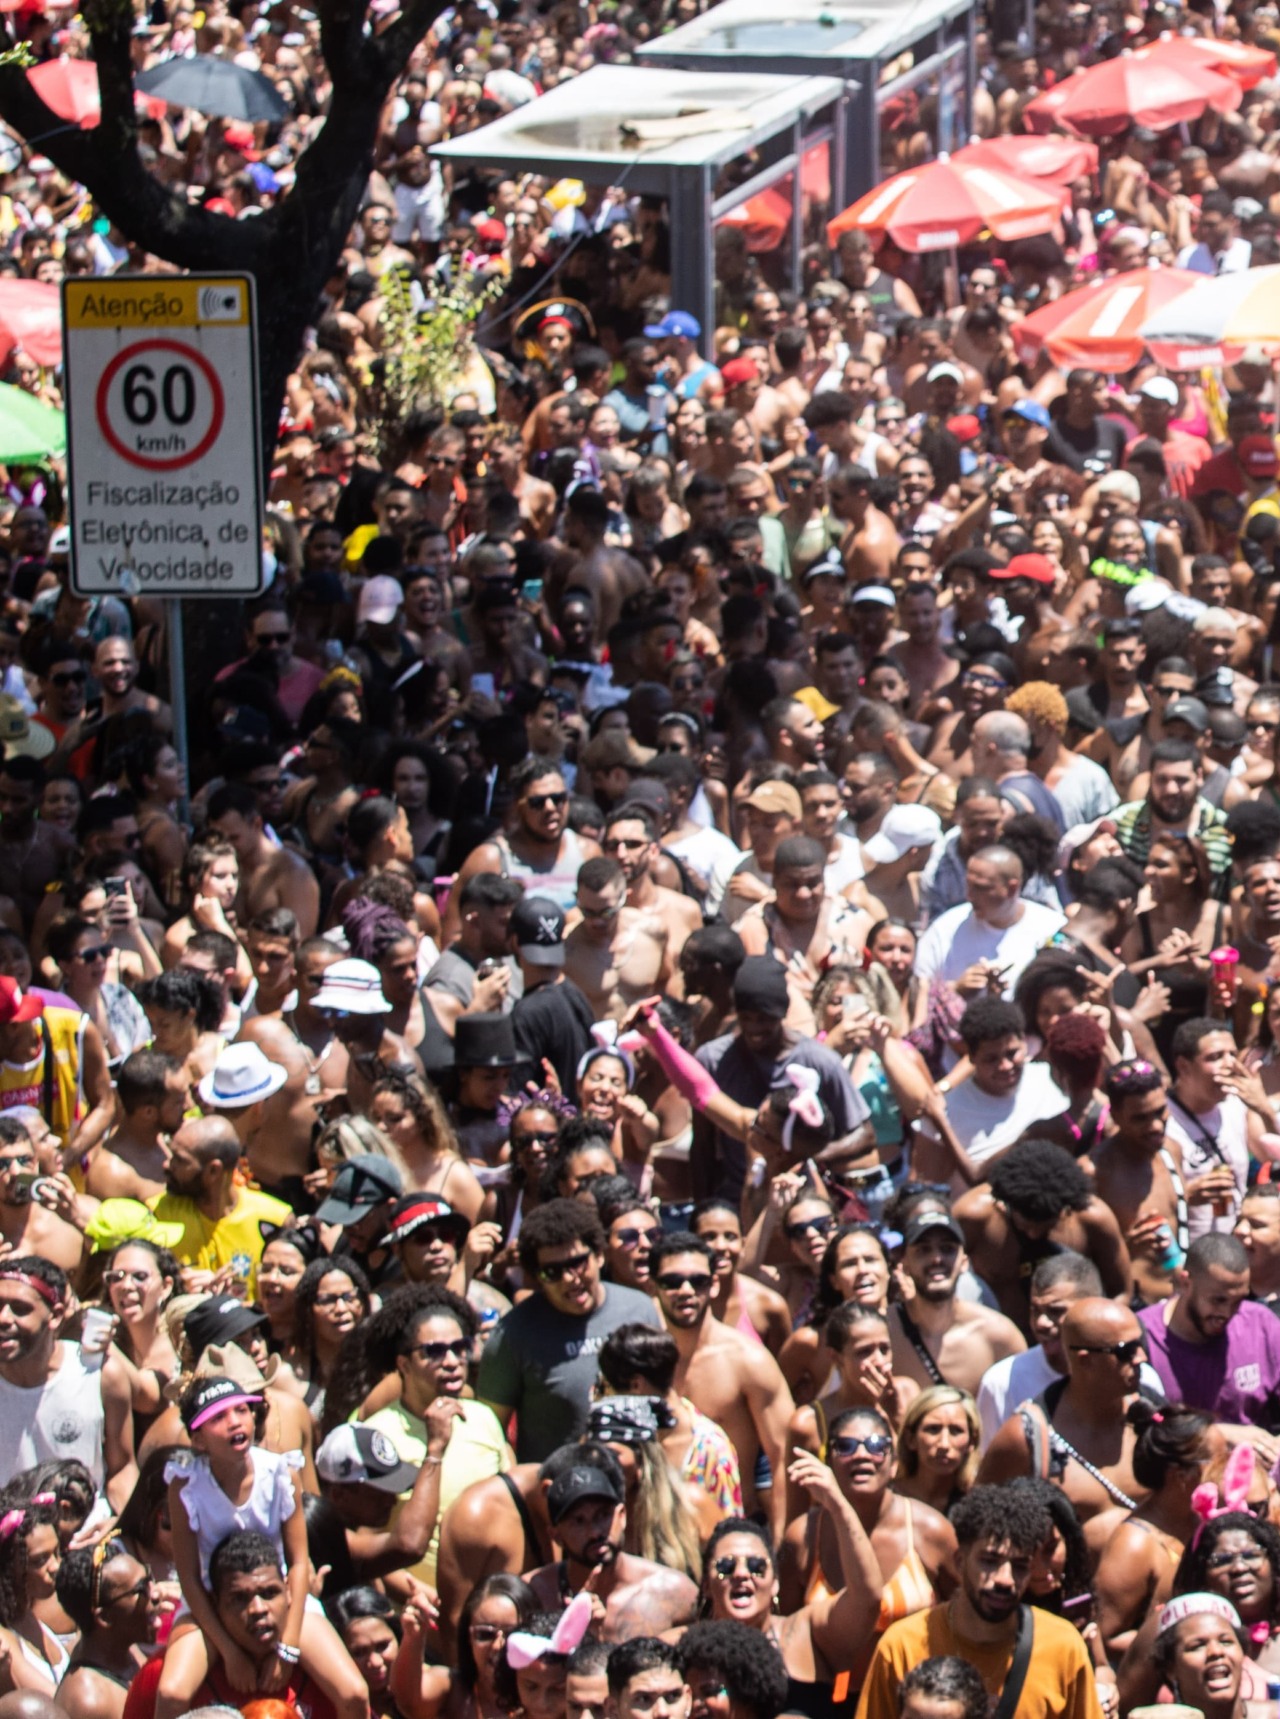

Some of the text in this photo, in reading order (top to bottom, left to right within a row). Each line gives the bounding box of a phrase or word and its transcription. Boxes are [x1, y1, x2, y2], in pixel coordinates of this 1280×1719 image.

[80, 292, 184, 320] Atenção
[122, 364, 196, 426] 60
[136, 434, 187, 453] km/h
[86, 480, 241, 510] Fiscalização
[217, 519, 249, 544] de
[99, 558, 235, 582] Velocidade
